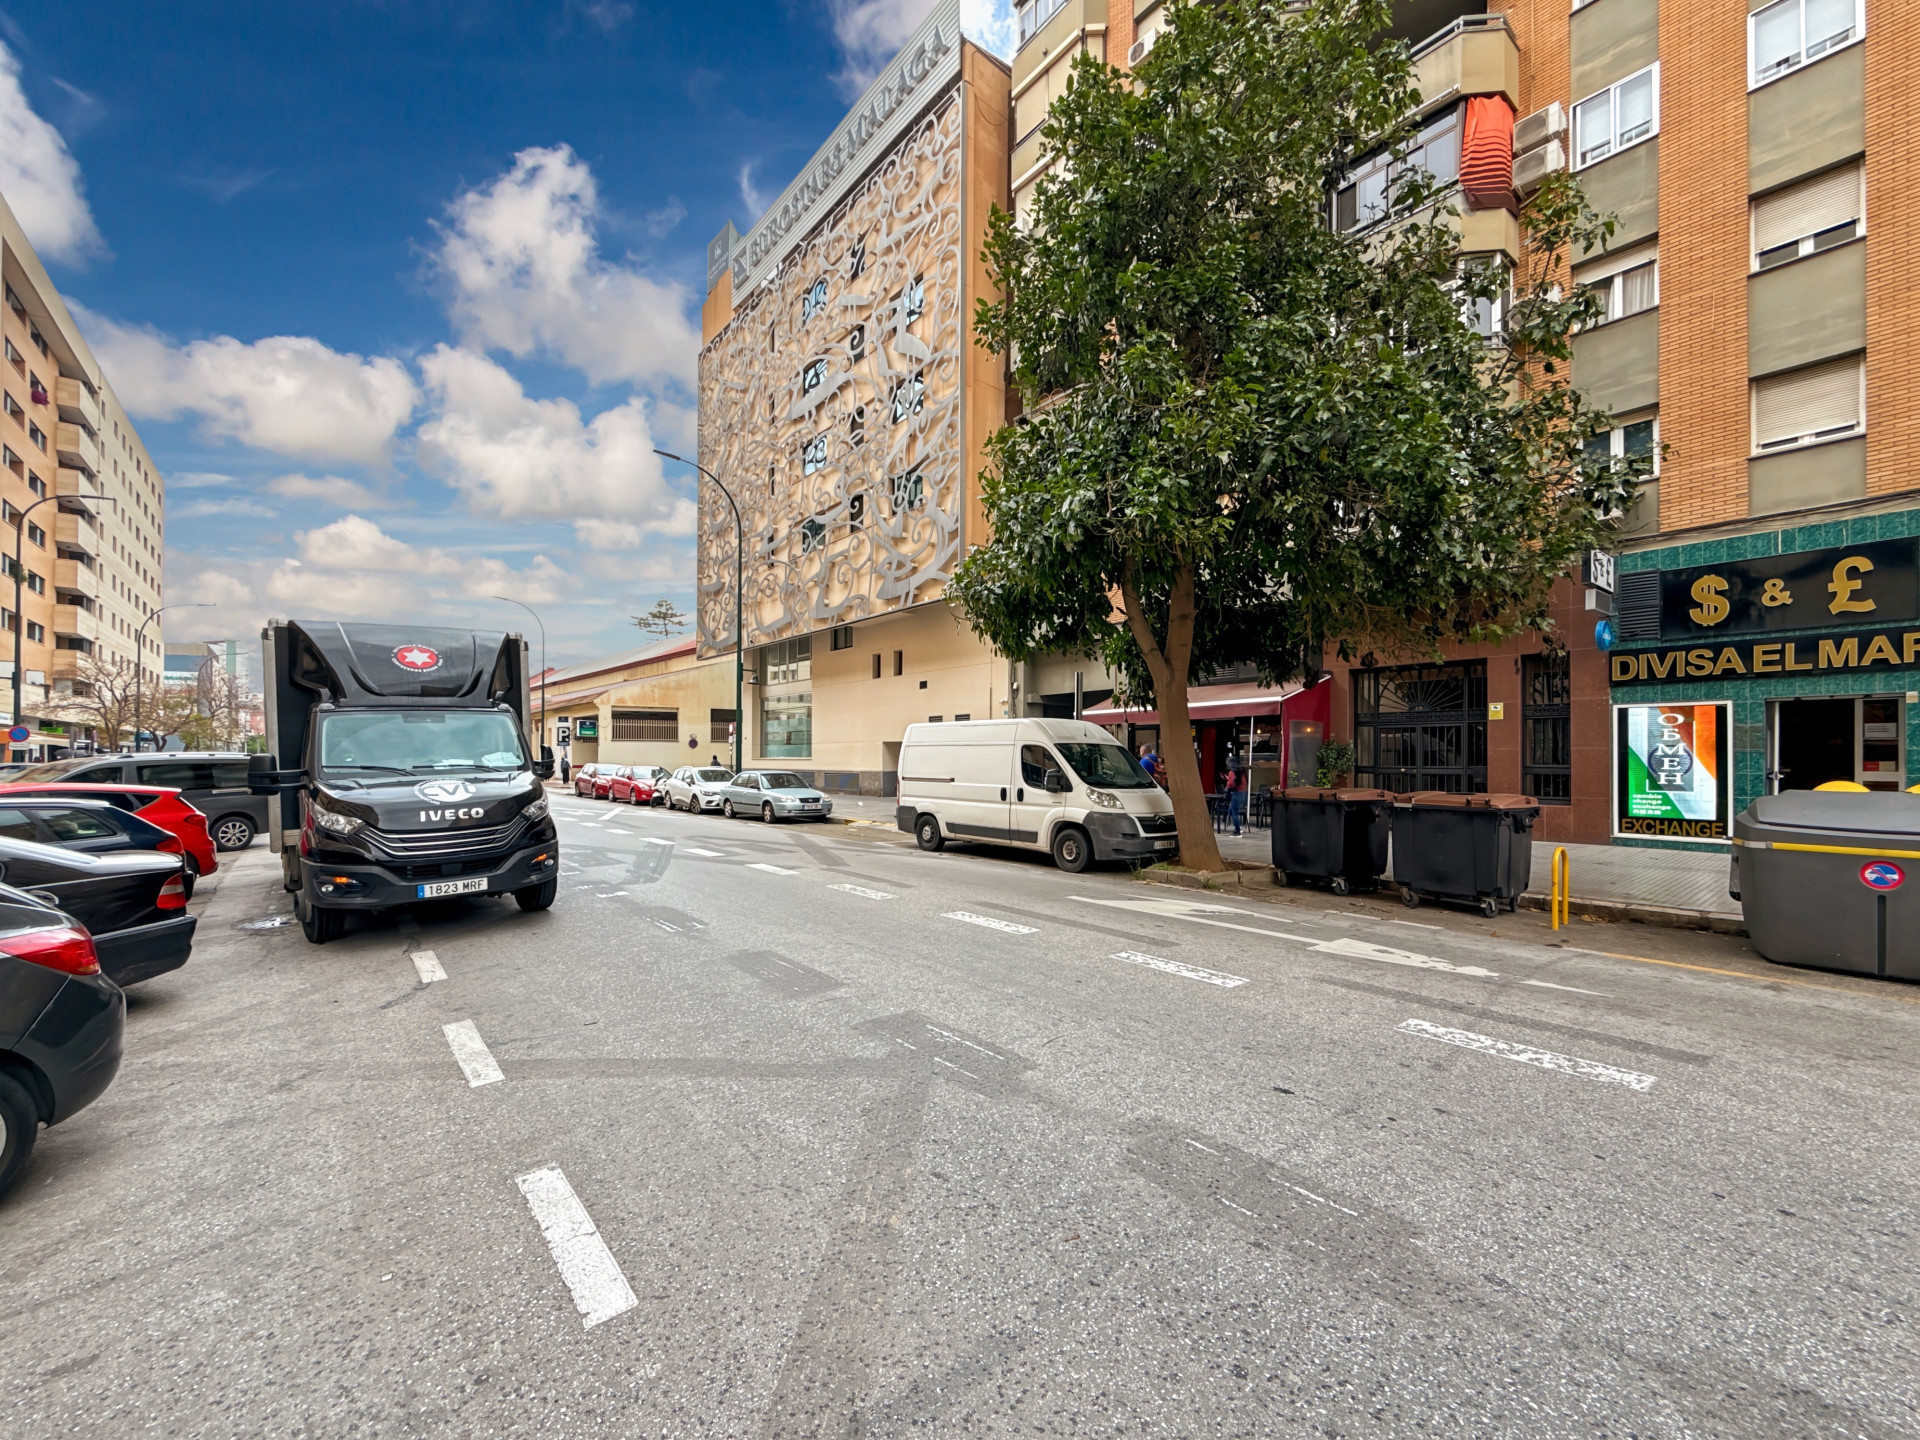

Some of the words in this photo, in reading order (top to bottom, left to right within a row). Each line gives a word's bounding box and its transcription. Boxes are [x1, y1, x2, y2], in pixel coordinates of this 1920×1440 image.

[750, 146, 848, 266] EUROSTARS
[1688, 574, 1730, 627] $
[1761, 578, 1794, 607] &
[1827, 556, 1877, 615] £
[1611, 647, 1746, 681] DIVISA
[1752, 642, 1813, 673] EL
[558, 728, 569, 742] P
[1656, 713, 1689, 785] ОБМЕН
[419, 807, 484, 823] IVECO
[1621, 818, 1724, 838] EXCHANGE
[428, 883, 459, 896] 1823
[462, 879, 484, 892] MRF
